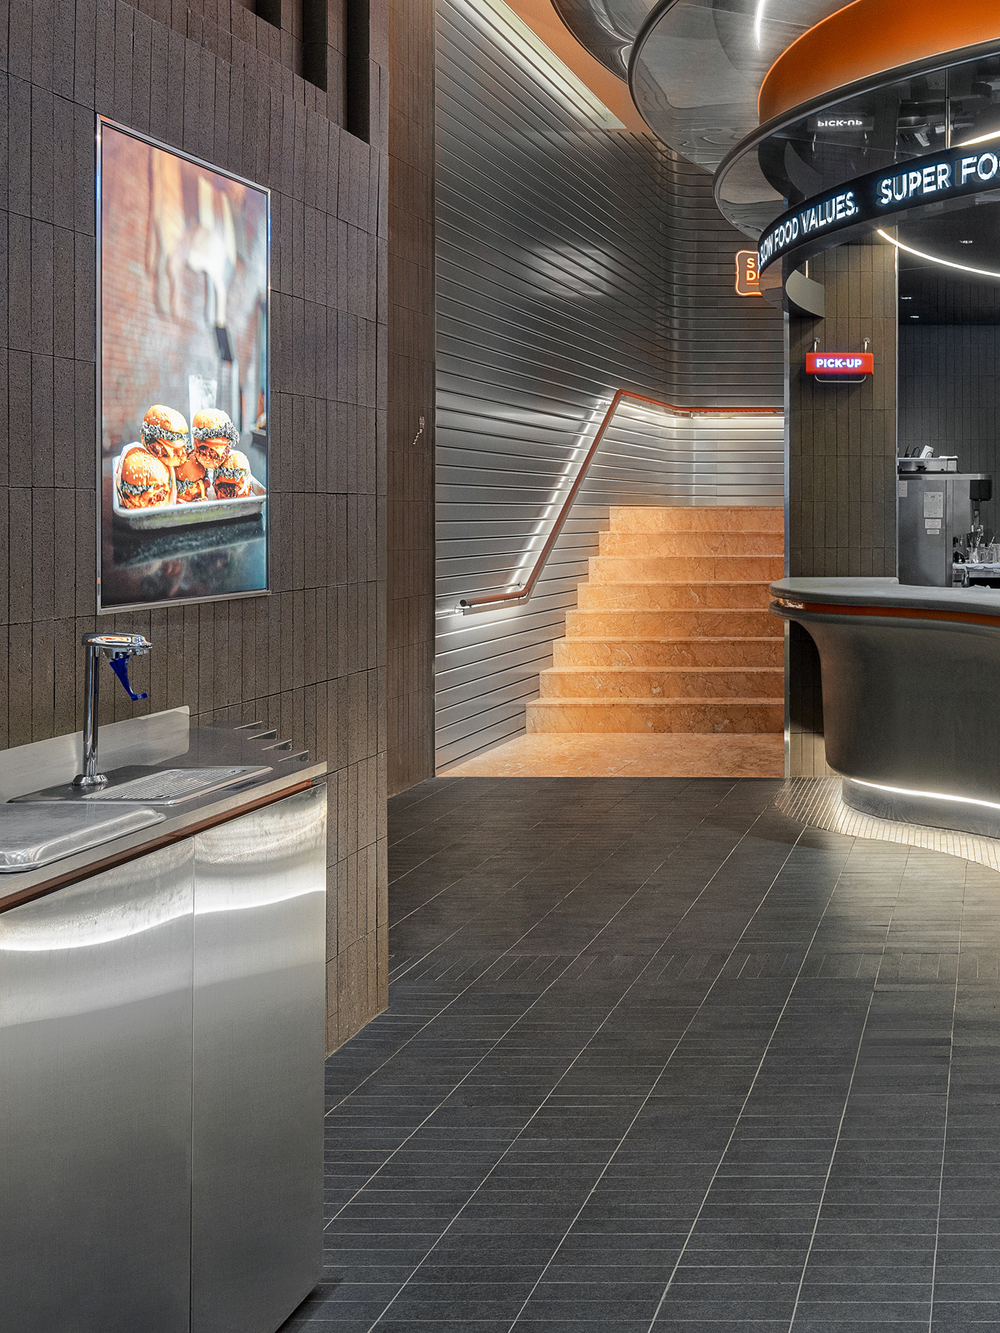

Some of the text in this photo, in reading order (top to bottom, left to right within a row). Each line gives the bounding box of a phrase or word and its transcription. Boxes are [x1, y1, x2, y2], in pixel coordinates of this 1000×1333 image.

[879, 162, 952, 205] SUPER
[774, 217, 799, 250] FOOD
[800, 191, 859, 235] VALUES.
[815, 357, 863, 369] PICK-UP
